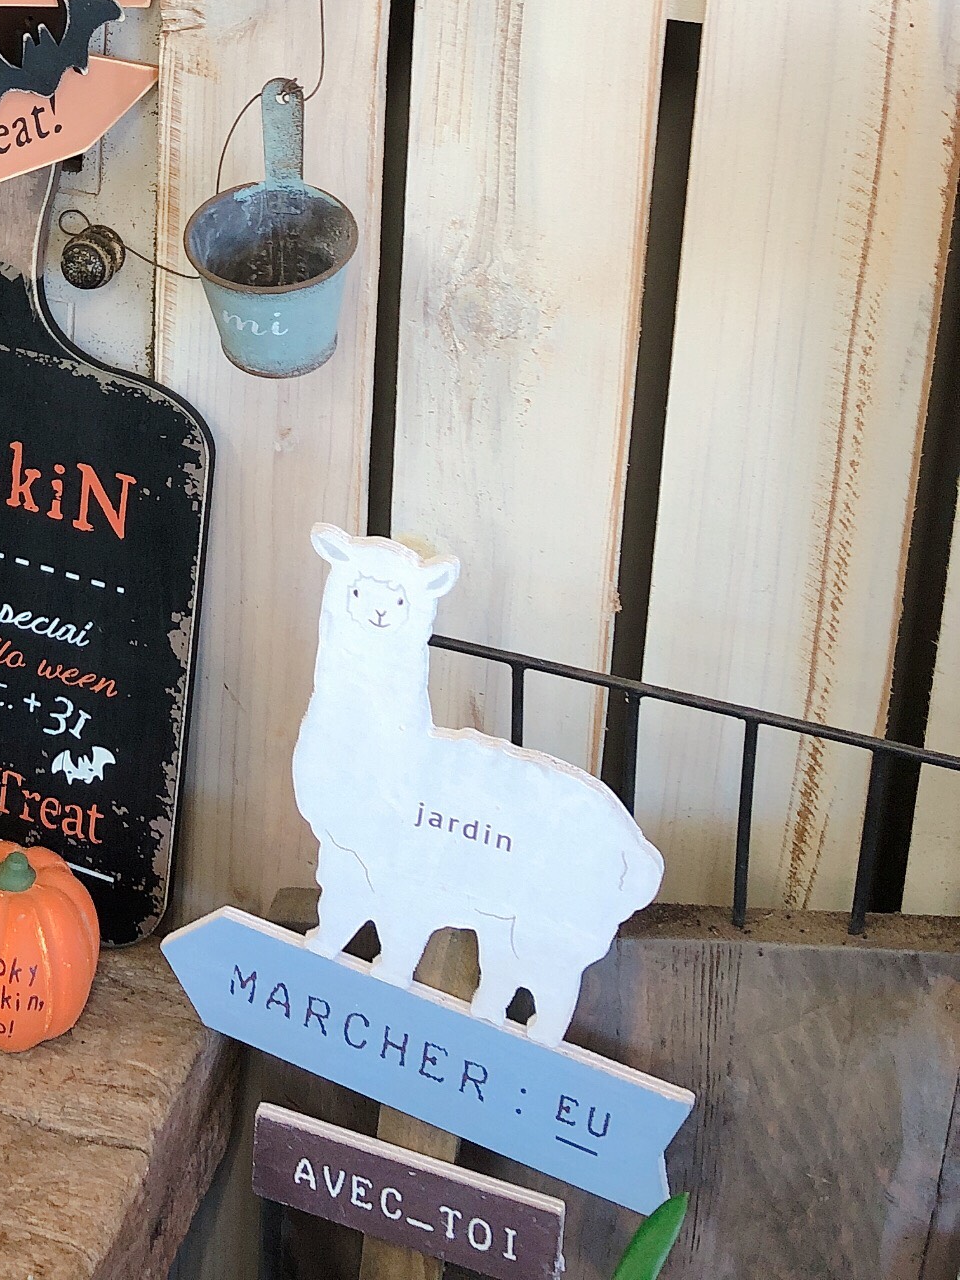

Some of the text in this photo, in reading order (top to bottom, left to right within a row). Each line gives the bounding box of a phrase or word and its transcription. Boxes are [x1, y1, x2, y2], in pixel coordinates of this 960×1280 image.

[222, 309, 289, 336] mi
[37, 658, 119, 698] ween
[42, 695, 92, 740] 31
[413, 801, 512, 853] jardin
[229, 964, 489, 1103] MARCHER
[554, 1094, 612, 1139] EU
